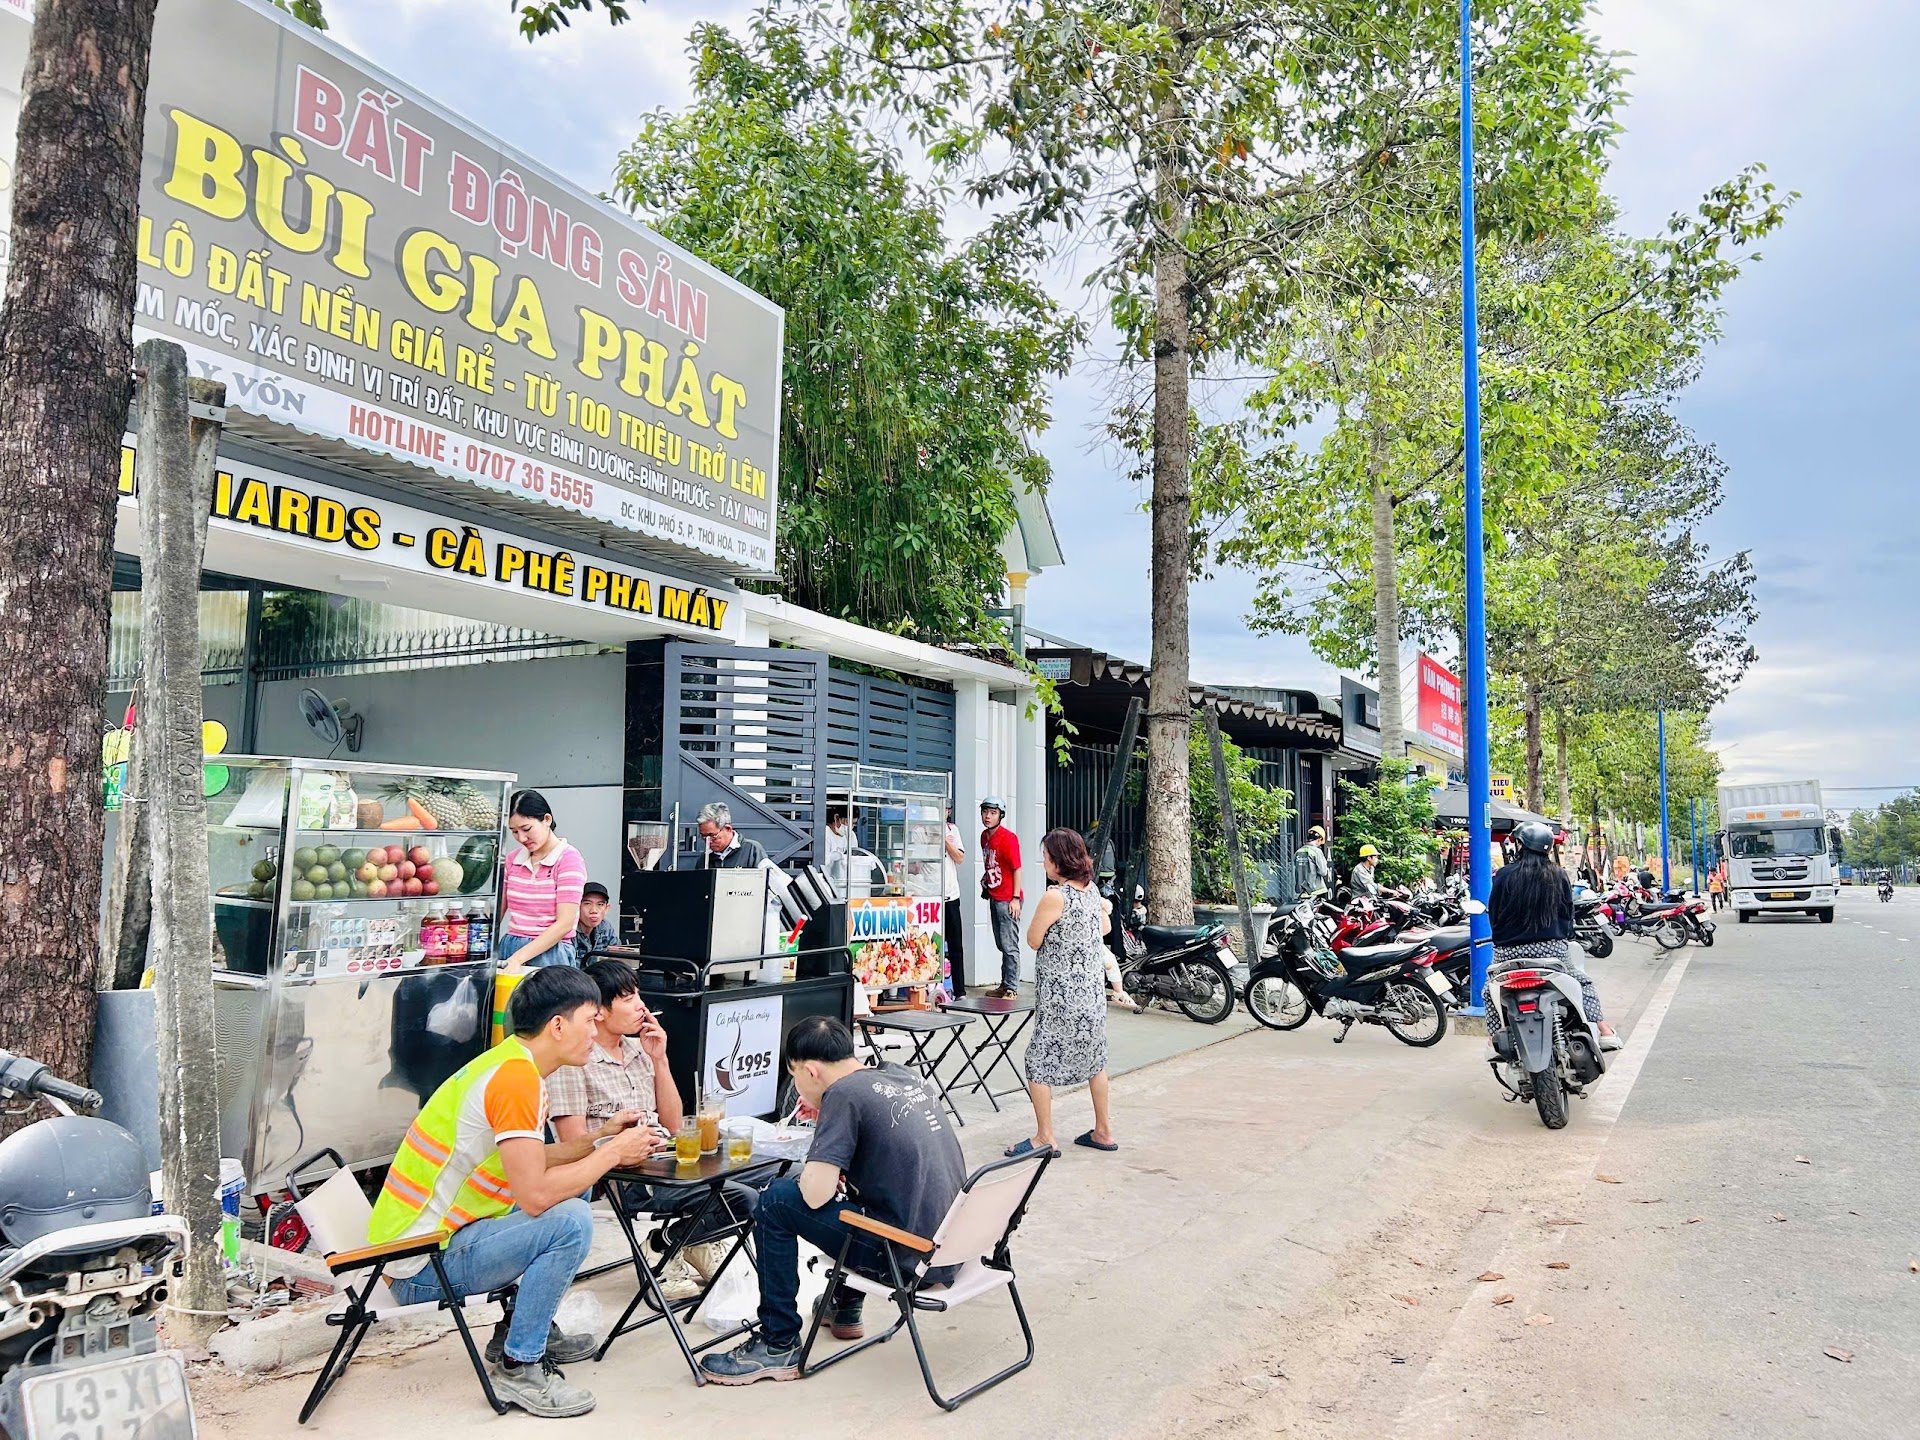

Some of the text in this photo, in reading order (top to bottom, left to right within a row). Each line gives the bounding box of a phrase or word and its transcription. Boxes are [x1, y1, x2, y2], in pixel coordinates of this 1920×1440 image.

[161, 108, 375, 279] BÙI
[401, 230, 557, 360] GIA
[294, 63, 708, 343] BẤT ĐỘNG SẢN
[207, 243, 291, 315] ĐẤT
[301, 281, 381, 351] NỀN
[390, 319, 446, 377] GIÁ
[456, 343, 495, 395] RẺ
[523, 371, 561, 417] TỪ
[566, 390, 611, 439] 100
[617, 410, 682, 467] TRIỆU
[687, 440, 727, 483] TRỞ
[730, 457, 766, 500] LÊN
[232, 371, 307, 415] VỐN
[174, 296, 240, 349] MỐC,
[248, 322, 298, 366] XÁC
[304, 343, 355, 386] ĐỊNH
[361, 362, 383, 402] VỊ
[389, 372, 421, 409] TRÍ
[425, 385, 468, 429] ĐẤT,
[472, 404, 509, 438] KHU
[513, 420, 547, 454] VỰC
[550, 430, 584, 466] BÌNH
[719, 494, 742, 522] TÂY
[744, 505, 768, 532] NINH
[348, 404, 447, 462] HOTLINE
[465, 444, 516, 483] 0707
[521, 462, 544, 493] 36
[550, 472, 594, 508] 5555
[620, 501, 636, 520] ĐC:
[638, 507, 656, 527] KHU
[658, 513, 676, 534] PHỐ
[750, 544, 767, 563] HCM
[426, 526, 487, 577] CÀ
[496, 543, 575, 596] PHÊ
[582, 565, 652, 614] PHA
[658, 583, 729, 630] MÁY
[851, 901, 907, 942] XÔI MẶN
[915, 902, 941, 925] 15K
[740, 1009, 754, 1025] pha
[736, 1051, 772, 1072] 1995
